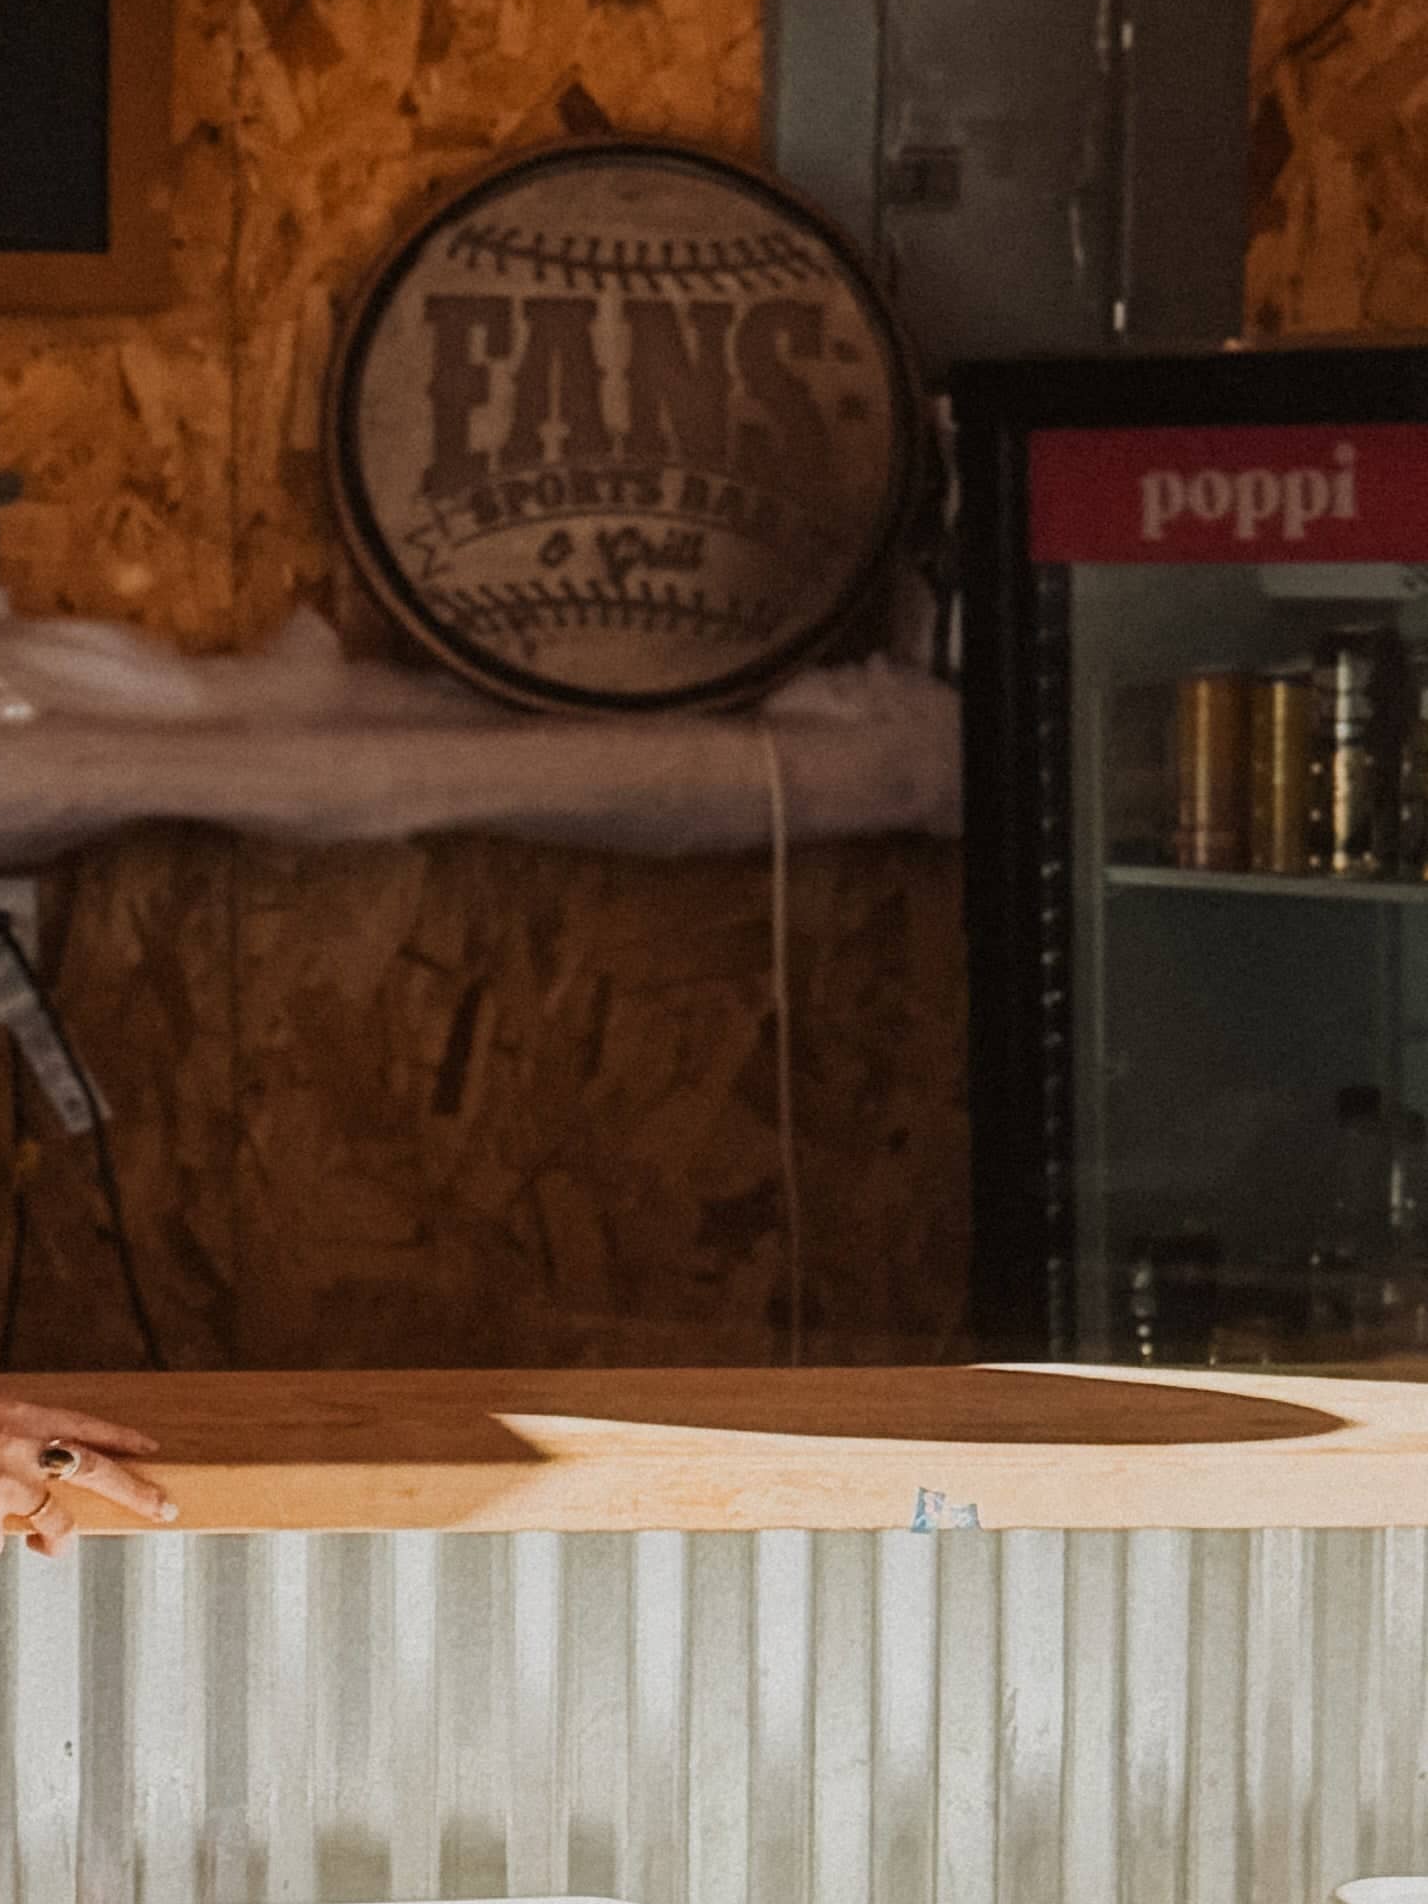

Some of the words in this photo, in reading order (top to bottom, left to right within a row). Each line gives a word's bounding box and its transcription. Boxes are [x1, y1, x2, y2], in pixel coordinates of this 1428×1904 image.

[423, 295, 834, 502] FANS
[470, 469, 664, 525] SPORTS
[1138, 442, 1359, 541] poppi
